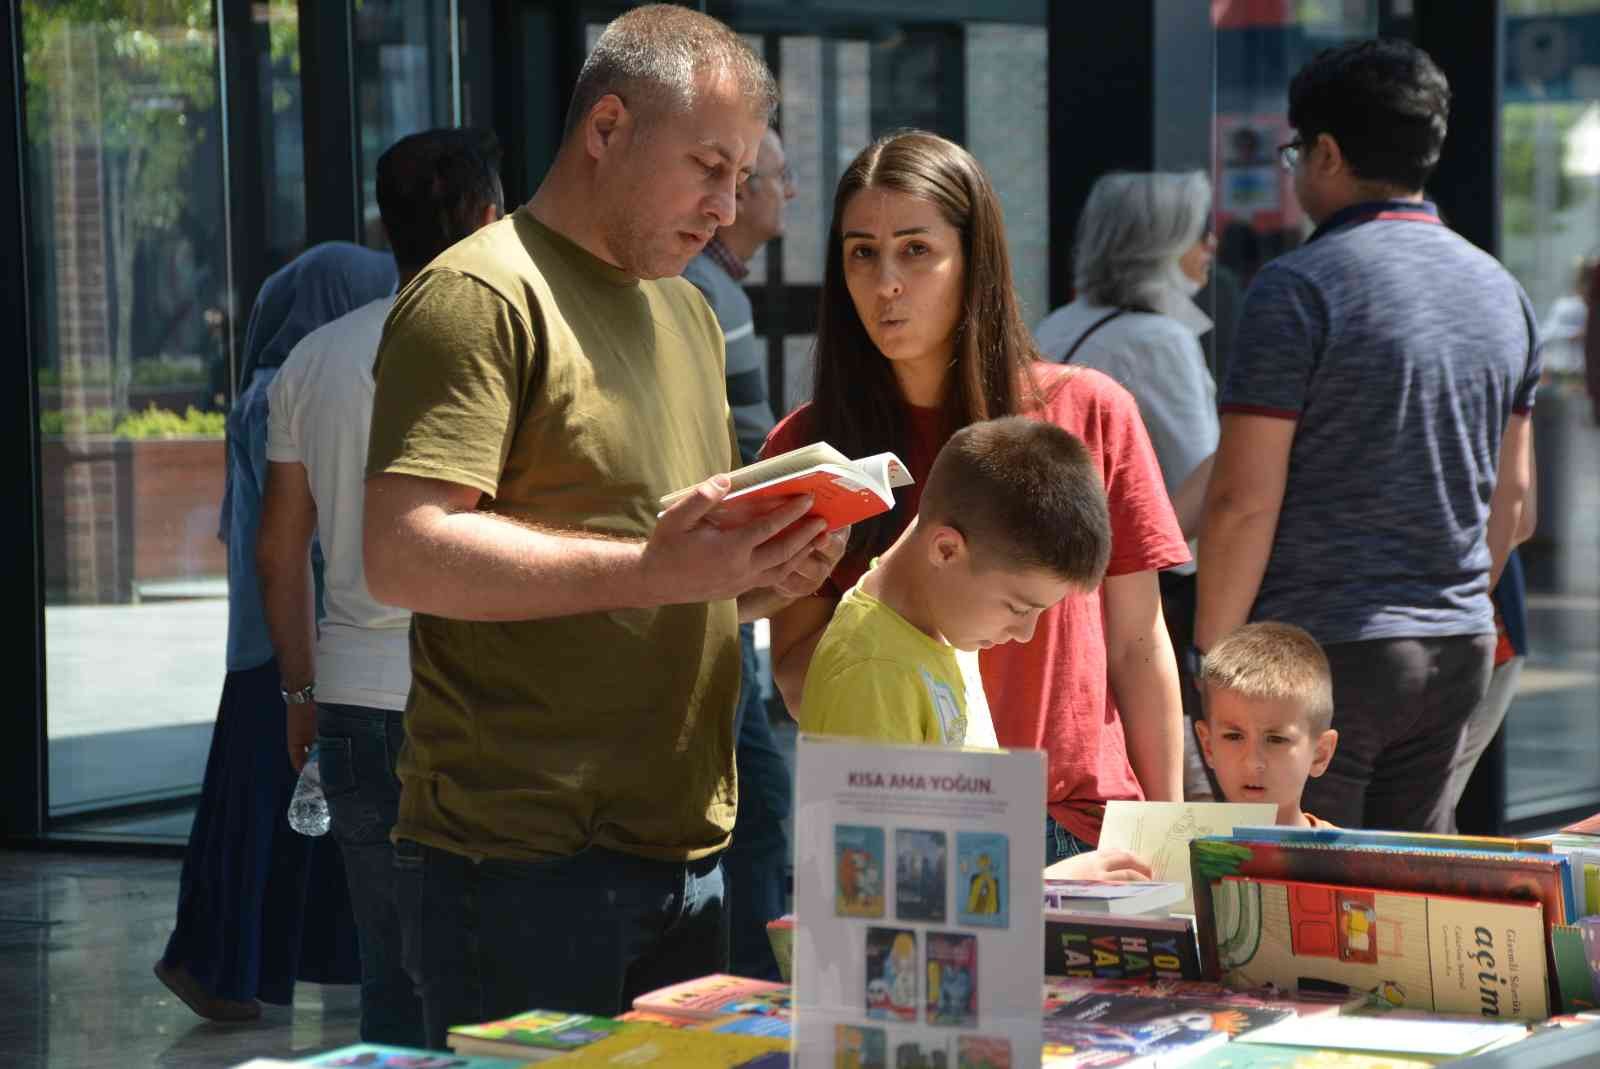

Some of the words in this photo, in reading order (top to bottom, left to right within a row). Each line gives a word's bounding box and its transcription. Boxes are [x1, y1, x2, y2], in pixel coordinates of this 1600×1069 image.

[847, 771, 885, 788] KISA
[889, 773, 926, 791] AMA
[1120, 936, 1150, 976] HA
